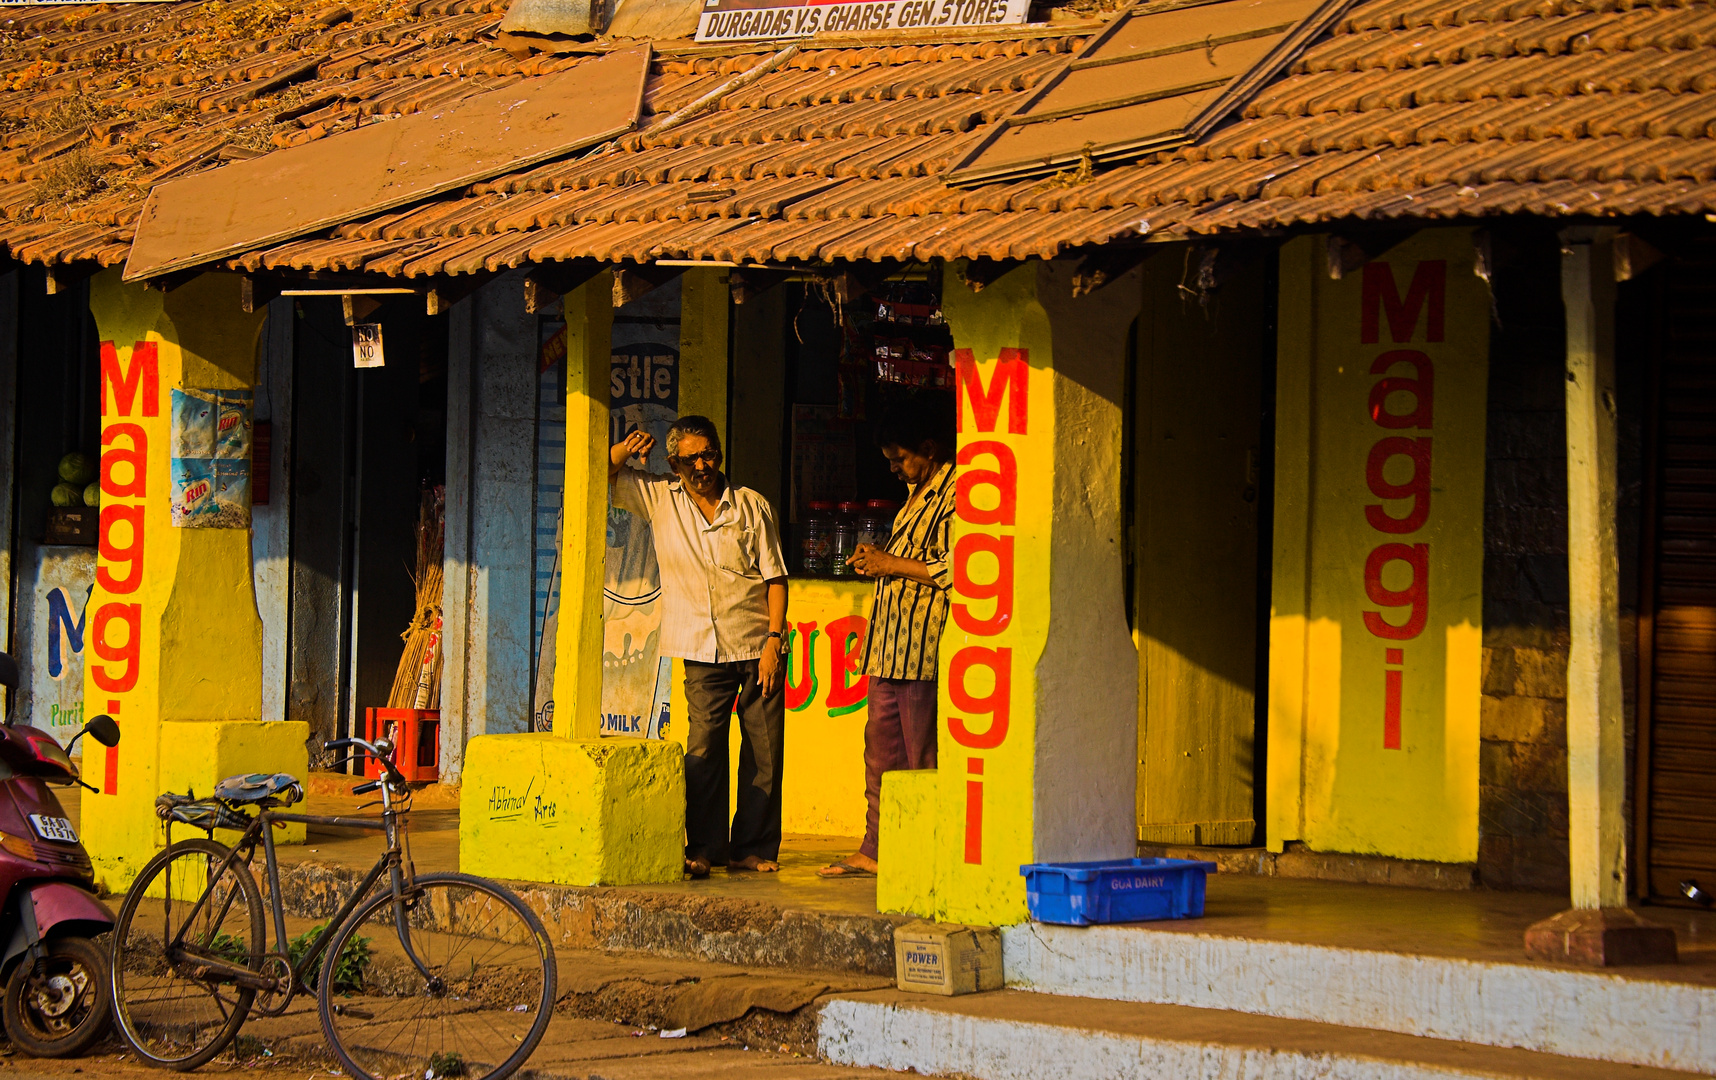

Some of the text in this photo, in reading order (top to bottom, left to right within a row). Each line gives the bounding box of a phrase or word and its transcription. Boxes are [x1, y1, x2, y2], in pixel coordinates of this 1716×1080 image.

[705, 10, 794, 38] DURGADAS
[823, 3, 896, 32] GHARSE
[360, 345, 374, 358] NO
[1361, 260, 1446, 750] Maggi
[91, 340, 159, 796] Maggi
[948, 349, 1030, 865] Maggi
[607, 713, 642, 733] MILK
[489, 776, 535, 812] Abhinav
[1111, 876, 1165, 890] GOA DAIRY
[906, 951, 938, 965] POWER
